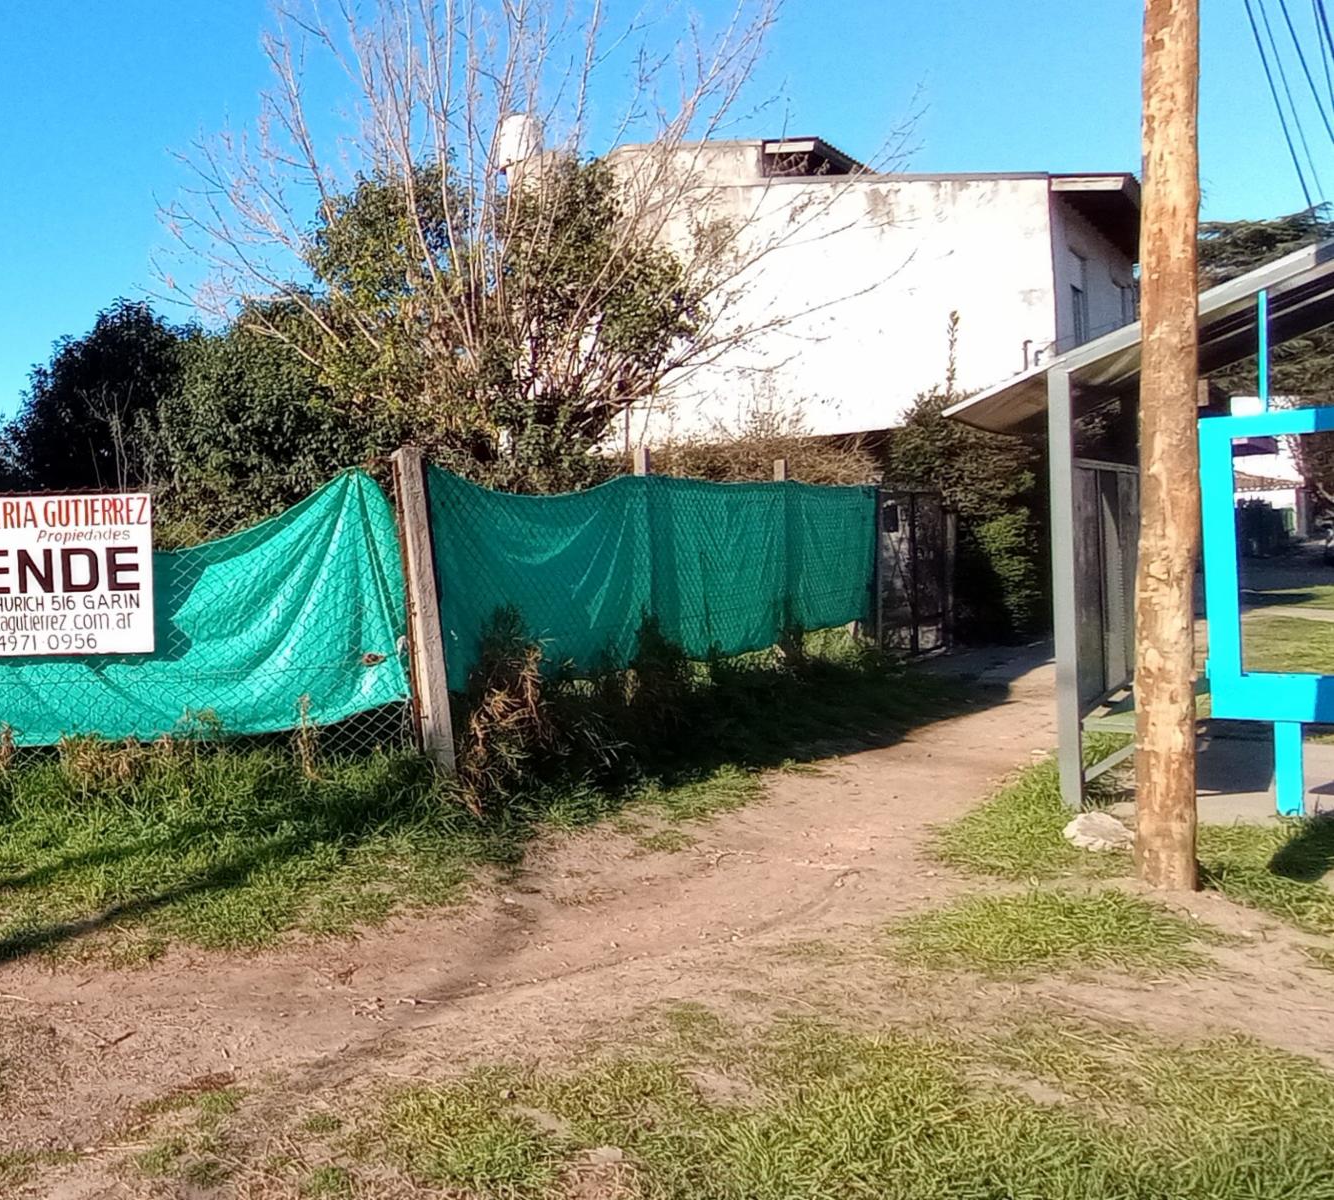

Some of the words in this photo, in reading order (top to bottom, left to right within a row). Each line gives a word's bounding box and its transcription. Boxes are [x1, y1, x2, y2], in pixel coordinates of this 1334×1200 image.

[43, 496, 148, 527] GUTIERREZ
[37, 528, 131, 545] Propiedades
[51, 595, 76, 611] 516
[83, 593, 140, 610] GARIN
